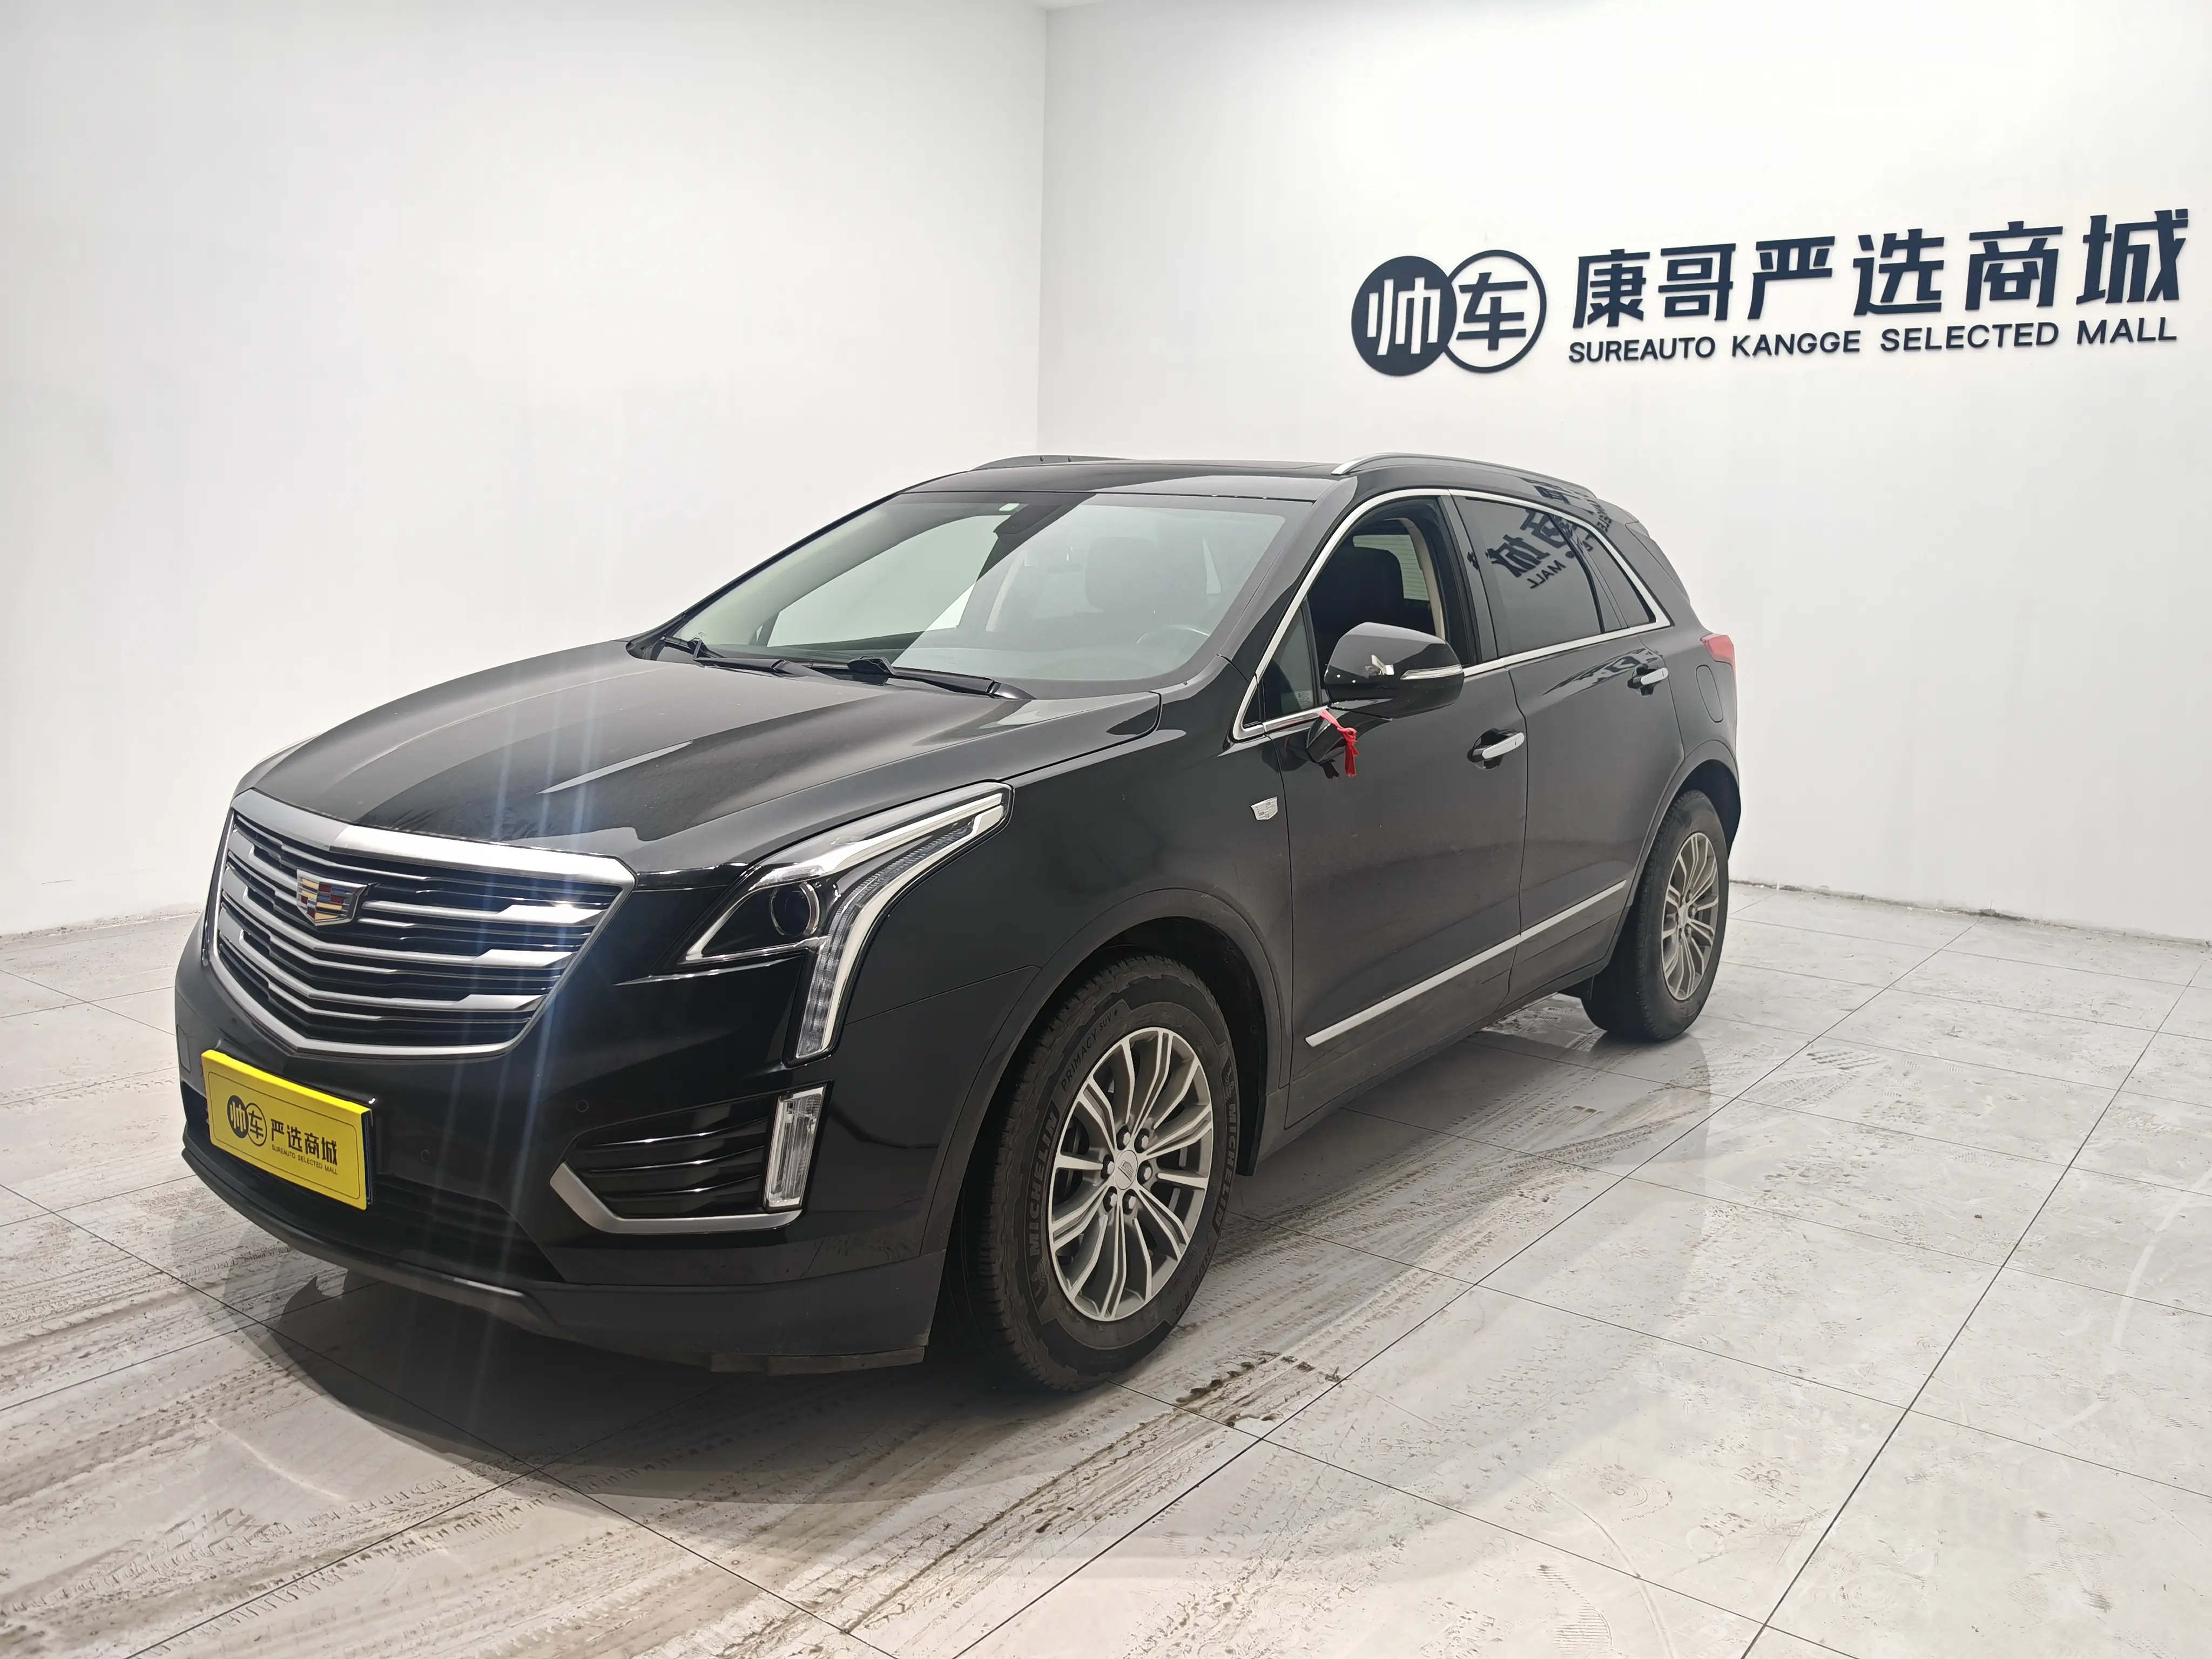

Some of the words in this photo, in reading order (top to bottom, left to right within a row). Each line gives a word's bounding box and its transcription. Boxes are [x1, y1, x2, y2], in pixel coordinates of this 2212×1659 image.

[1572, 208, 2189, 328] 康哥严选商城
[1367, 272, 1528, 355] 帅车
[1568, 336, 1716, 363] SUREAUTO
[1731, 330, 1861, 358] KANGGE
[1880, 322, 2059, 352] SELECTED
[2076, 317, 2177, 345] MALL
[1061, 1028, 1097, 1092] PRIMACY
[1099, 1012, 1111, 1031] SUV
[230, 1101, 264, 1139] 帅车
[271, 1118, 338, 1166] 严选商城
[272, 1144, 296, 1159] SUREAUTO
[298, 1155, 323, 1169] SELECTED
[325, 1165, 338, 1175] MALL
[1028, 1110, 1059, 1257] MICHELIN
[1215, 1103, 1236, 1228] MICHELIN
